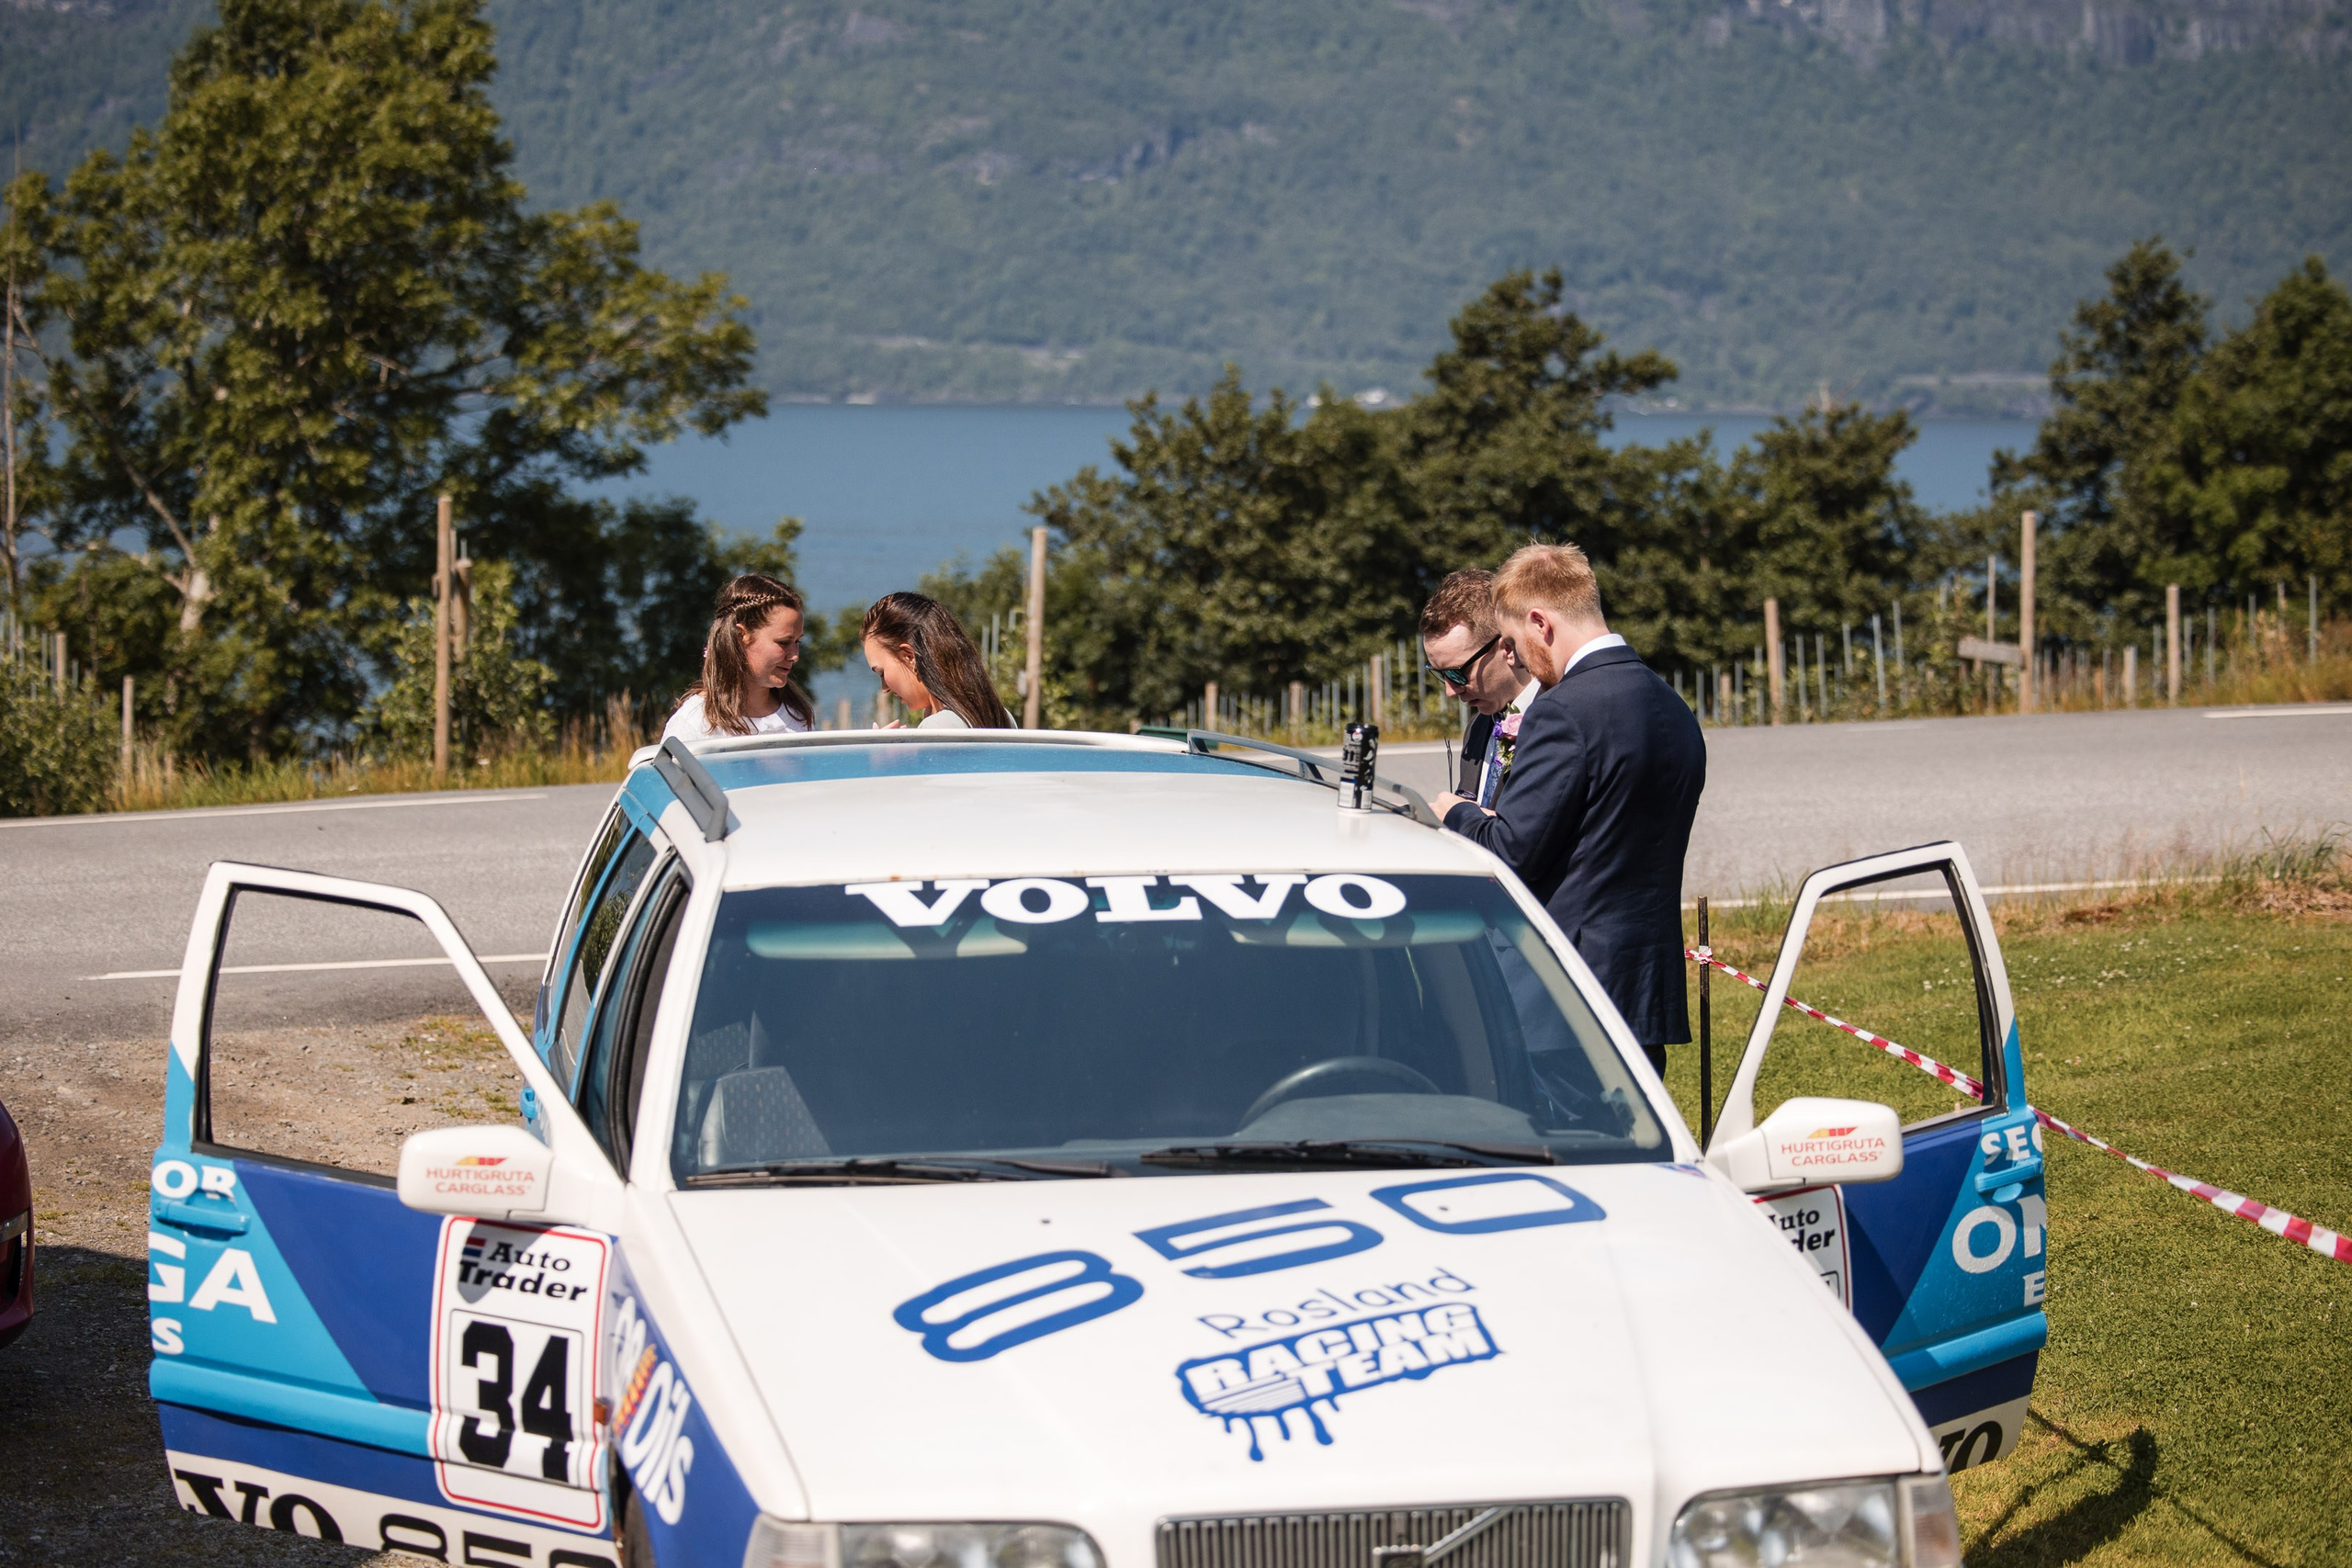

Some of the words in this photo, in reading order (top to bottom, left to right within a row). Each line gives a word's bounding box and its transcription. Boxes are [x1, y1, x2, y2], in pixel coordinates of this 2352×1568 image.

[845, 873, 1407, 927] VOLVO
[1781, 1137, 1885, 1154] HURTIGRUTA
[1792, 1151, 1879, 1167] CARGLASS
[152, 1159, 237, 1207] OR
[425, 1168, 535, 1182] HURTIGRUTA
[435, 1181, 526, 1196] CARGLASS
[459, 1259, 588, 1301] Trader
[487, 1241, 571, 1272] Auto
[893, 1172, 1607, 1362] 850
[1196, 1266, 1477, 1339] Rosland
[1184, 1303, 1478, 1400] RACING
[1286, 1326, 1491, 1398] TEAM
[459, 1320, 574, 1483] 34
